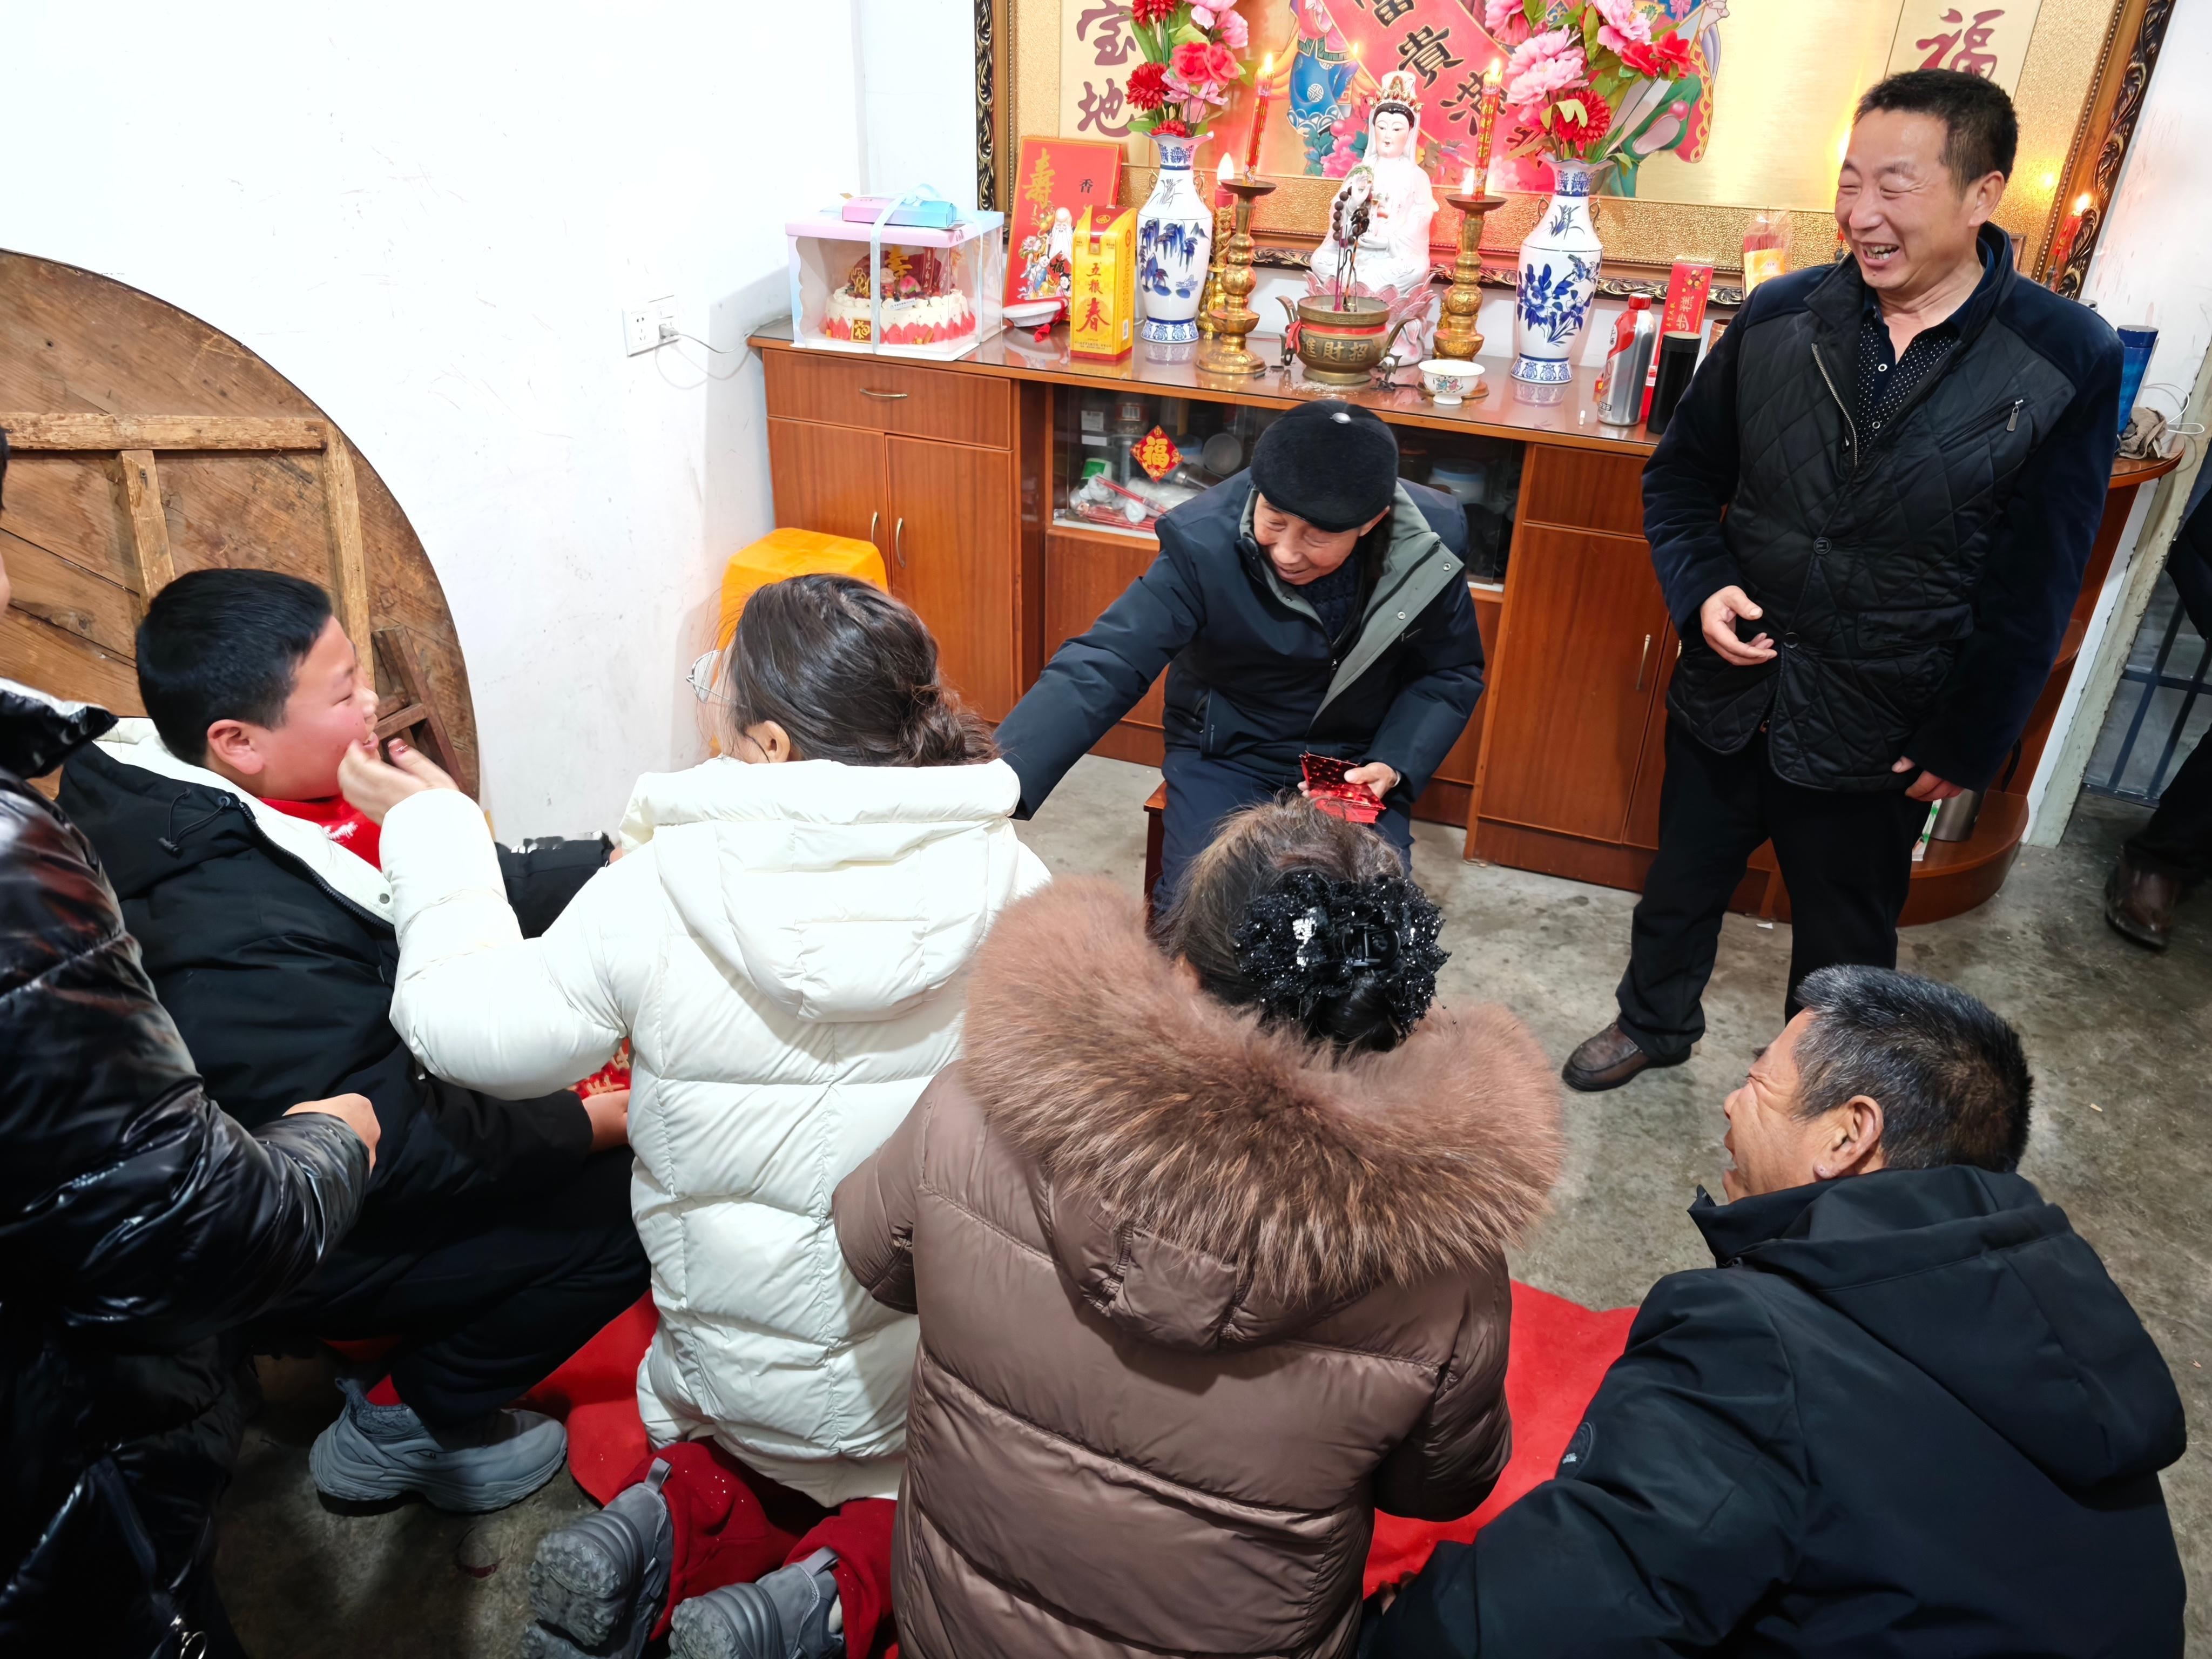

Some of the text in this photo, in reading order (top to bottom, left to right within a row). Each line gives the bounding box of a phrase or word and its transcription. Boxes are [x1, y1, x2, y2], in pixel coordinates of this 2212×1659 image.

[1916, 8, 2005, 81] 福
[1076, 262, 1111, 333] 五粮春
[1142, 435, 1170, 468] 福
